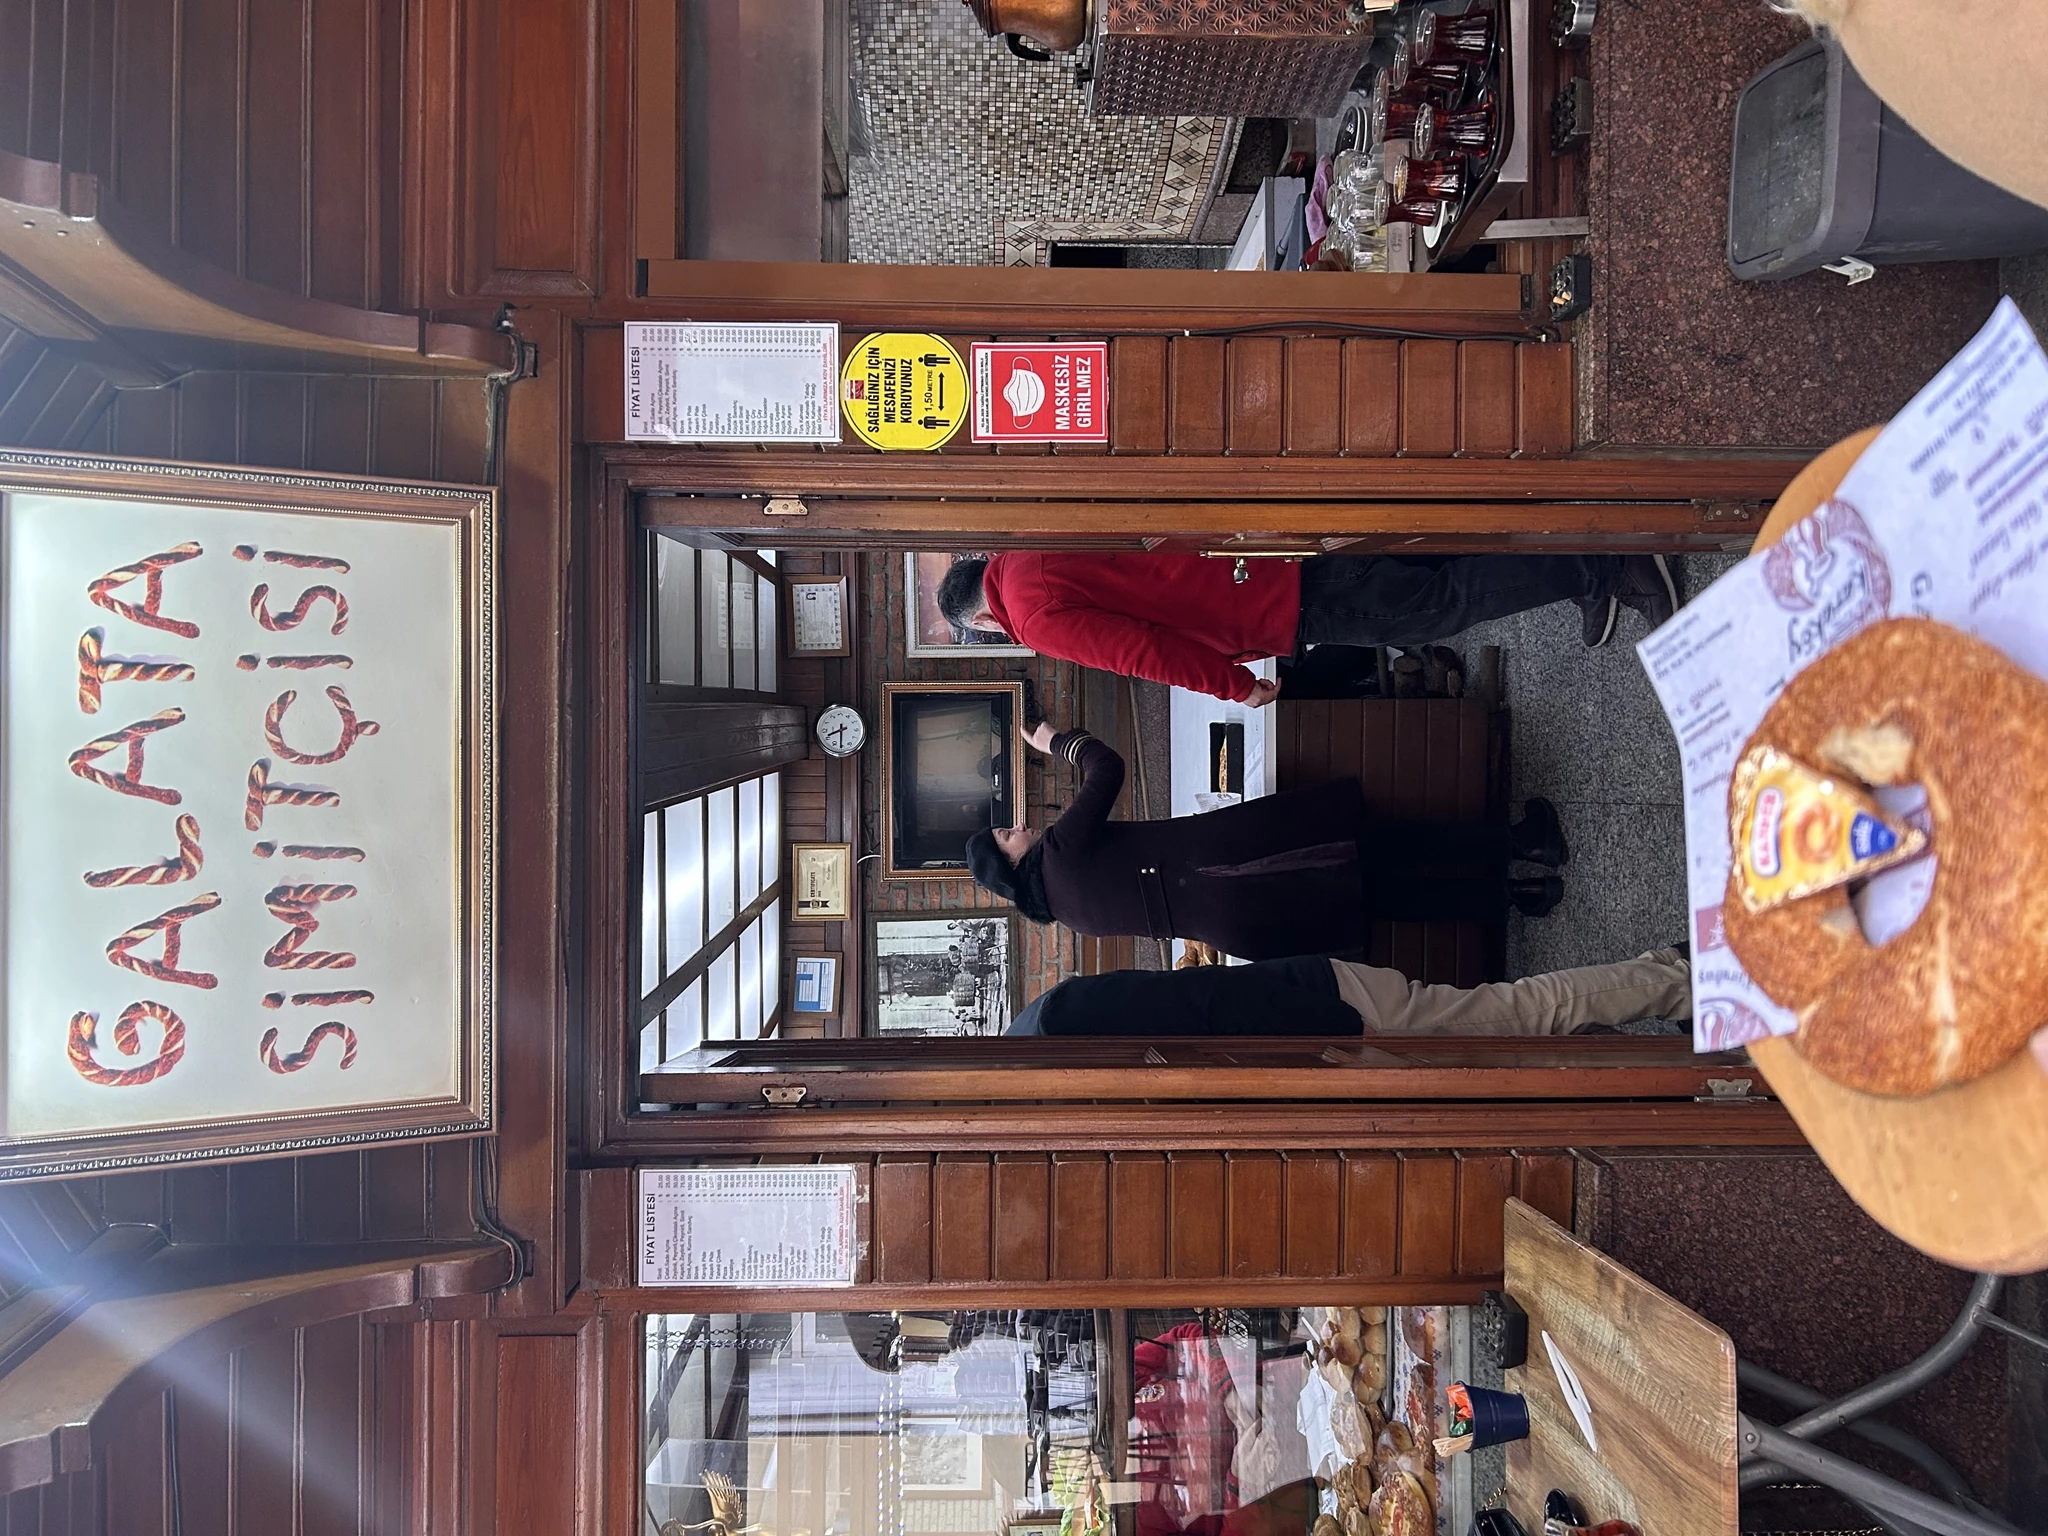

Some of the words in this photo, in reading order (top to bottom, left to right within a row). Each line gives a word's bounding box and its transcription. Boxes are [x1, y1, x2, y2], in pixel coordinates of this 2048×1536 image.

[630, 347, 640, 385] LİSTESİ
[866, 347, 882, 369] İÇİN
[630, 388, 640, 418] FİYAT
[865, 373, 879, 433] SAĞLIĞINIZ
[882, 358, 896, 423] MESAFENİZİ
[900, 359, 912, 423] KORUYUNUZ
[924, 392, 934, 412] 1,50
[1052, 355, 1070, 429] MASKESİZ
[1073, 357, 1091, 428] GİRİLMEZ
[66, 540, 222, 1088] GALATA
[232, 546, 380, 1074] SİMİTÇİSİ
[645, 1194, 655, 1232] LİSTESİ
[645, 1235, 655, 1264] FİYAT
